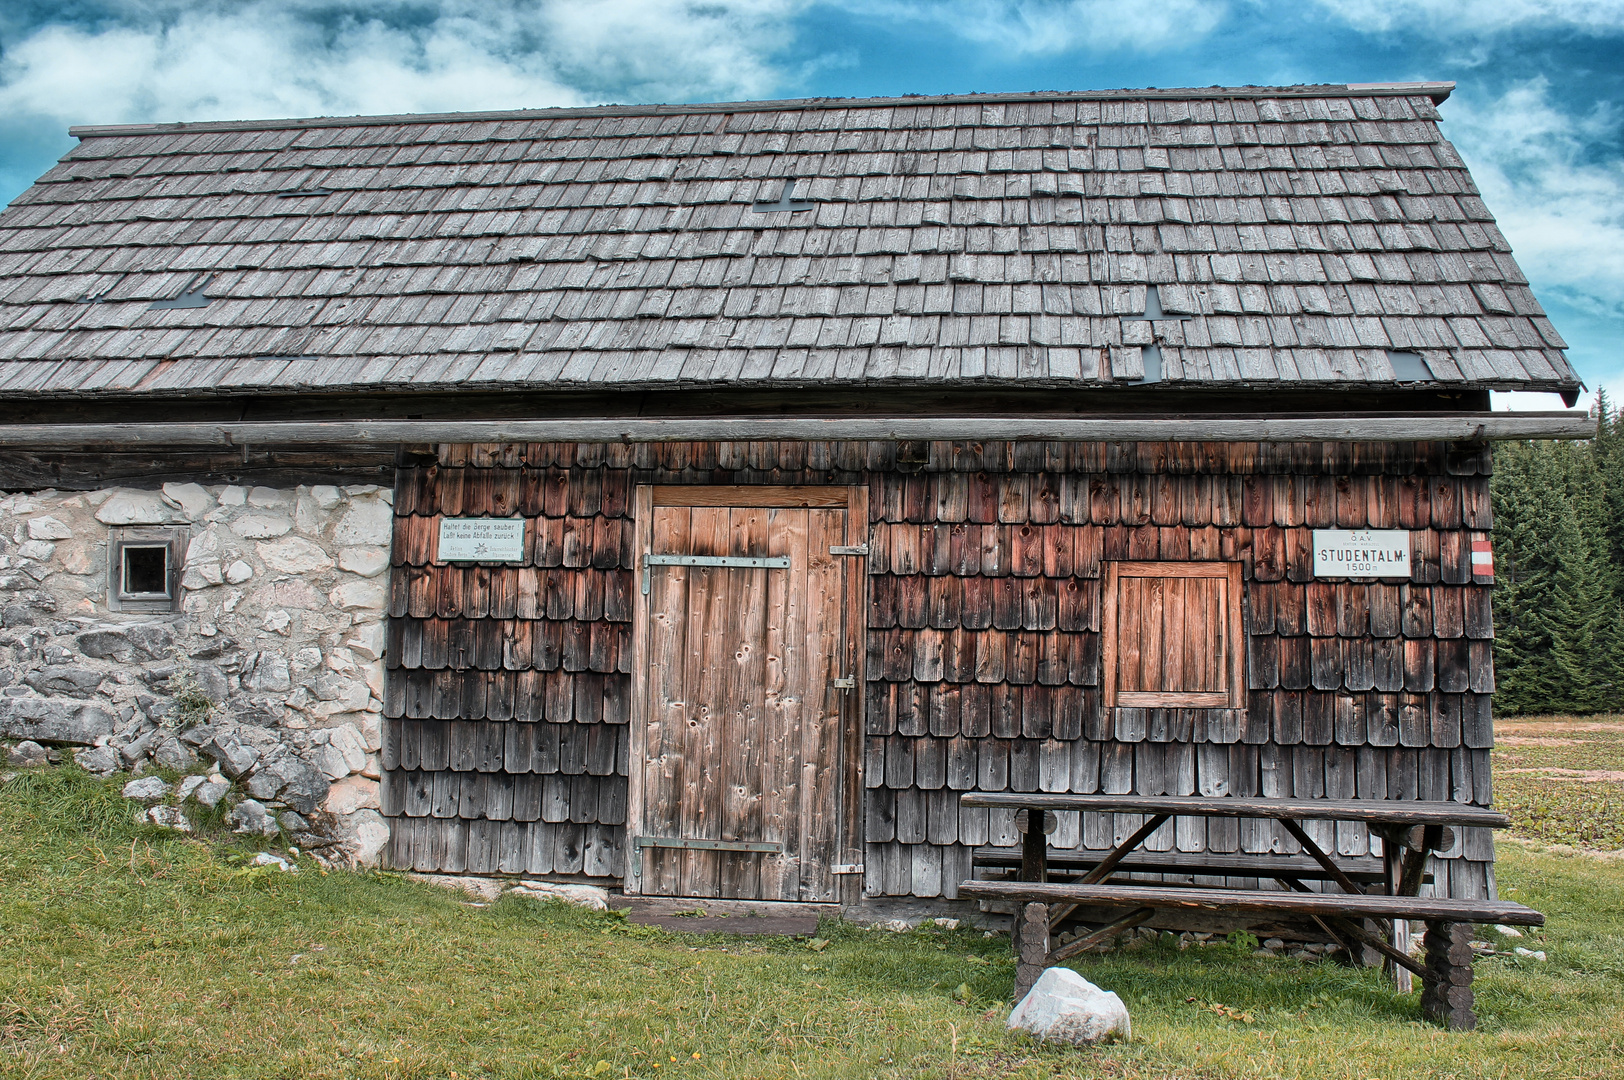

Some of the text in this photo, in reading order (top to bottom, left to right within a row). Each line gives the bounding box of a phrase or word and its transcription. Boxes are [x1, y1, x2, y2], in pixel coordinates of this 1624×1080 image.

[473, 522, 491, 532] Berge
[493, 523, 515, 531] sauber
[1321, 549, 1403, 562] STUDENTALM
